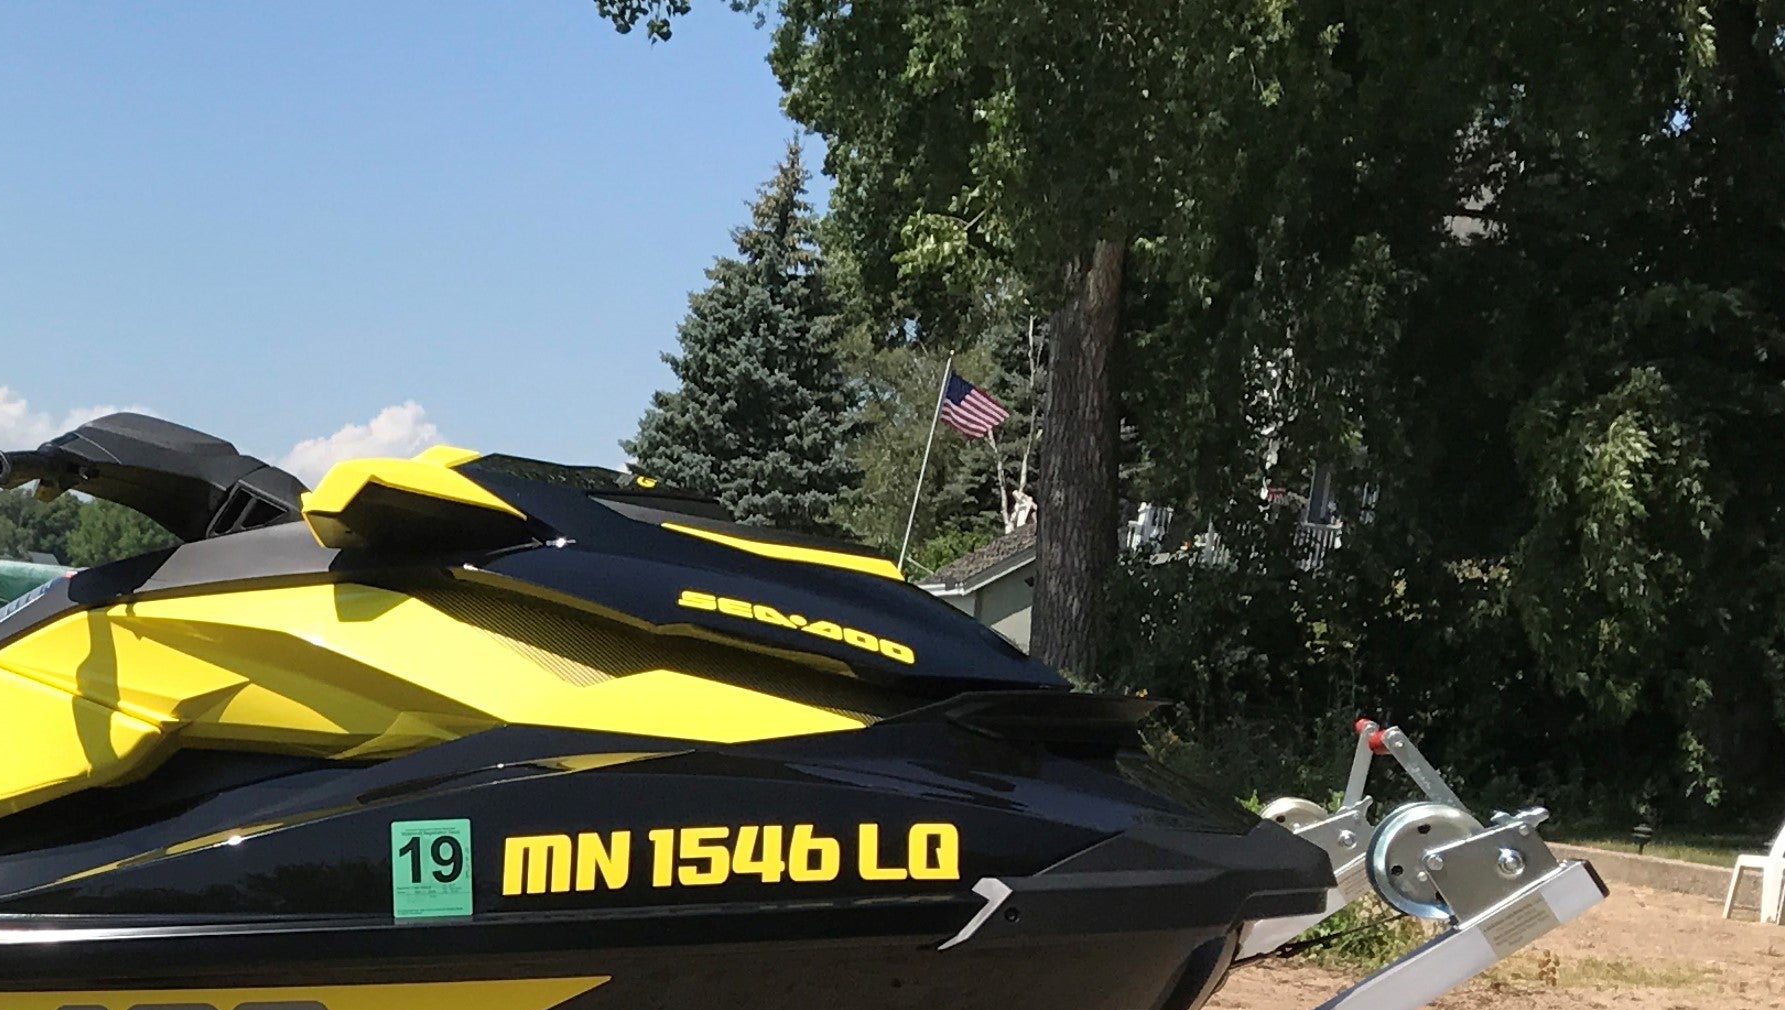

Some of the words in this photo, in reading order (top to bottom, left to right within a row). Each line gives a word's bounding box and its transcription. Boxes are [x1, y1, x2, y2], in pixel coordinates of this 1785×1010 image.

[399, 835, 464, 884] 19
[502, 831, 631, 895] MN
[648, 824, 841, 888] 1546
[858, 822, 961, 881] LQ
